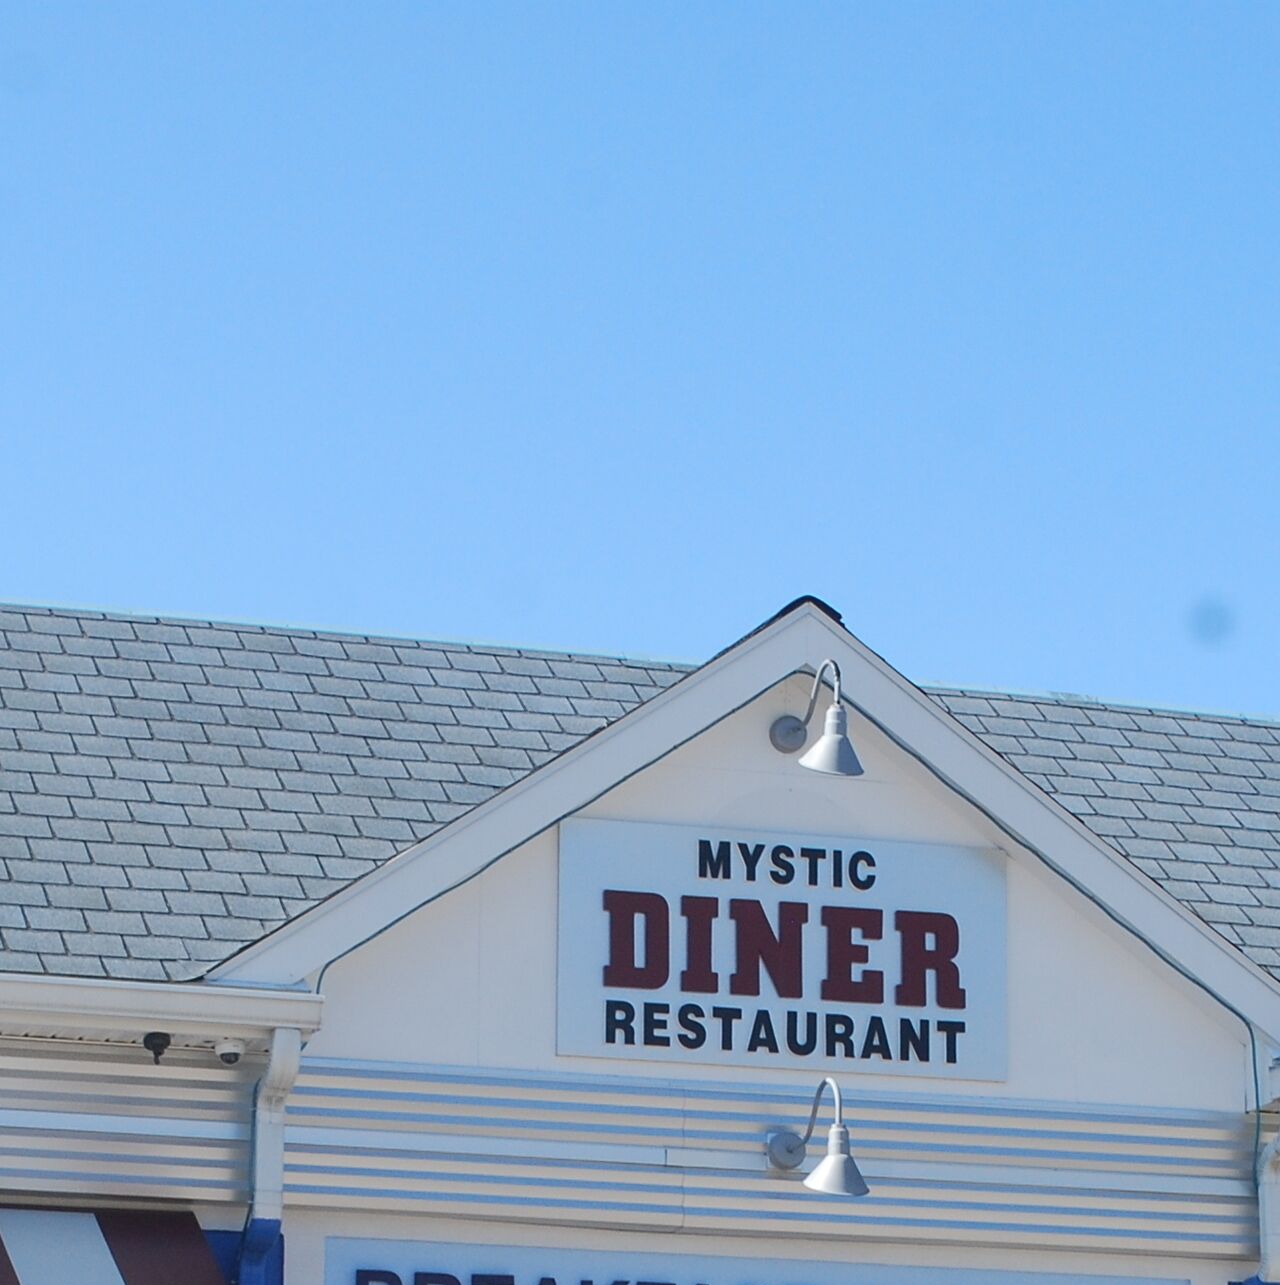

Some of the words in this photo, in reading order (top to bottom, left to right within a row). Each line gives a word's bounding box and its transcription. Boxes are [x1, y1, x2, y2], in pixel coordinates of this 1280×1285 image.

[698, 839, 876, 890] MYSTIC
[603, 889, 966, 1009] DINER
[604, 1000, 966, 1064] RESTAURANT
